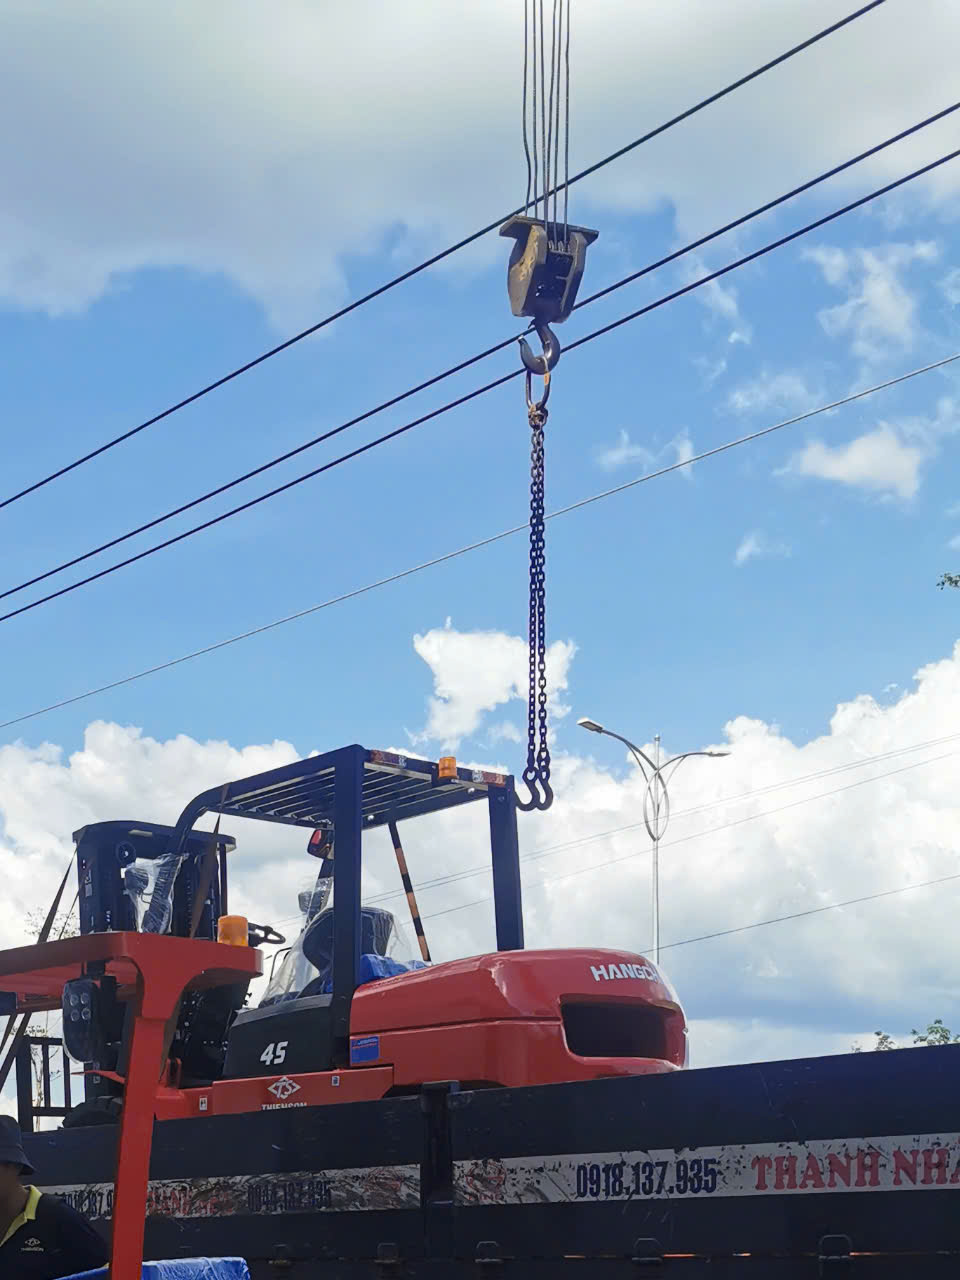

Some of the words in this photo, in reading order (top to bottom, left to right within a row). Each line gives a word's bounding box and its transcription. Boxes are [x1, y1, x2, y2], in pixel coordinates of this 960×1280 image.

[260, 1041, 289, 1065] 45
[576, 1158, 719, 1198] 0918.137.935
[751, 1151, 881, 1191] THANH
